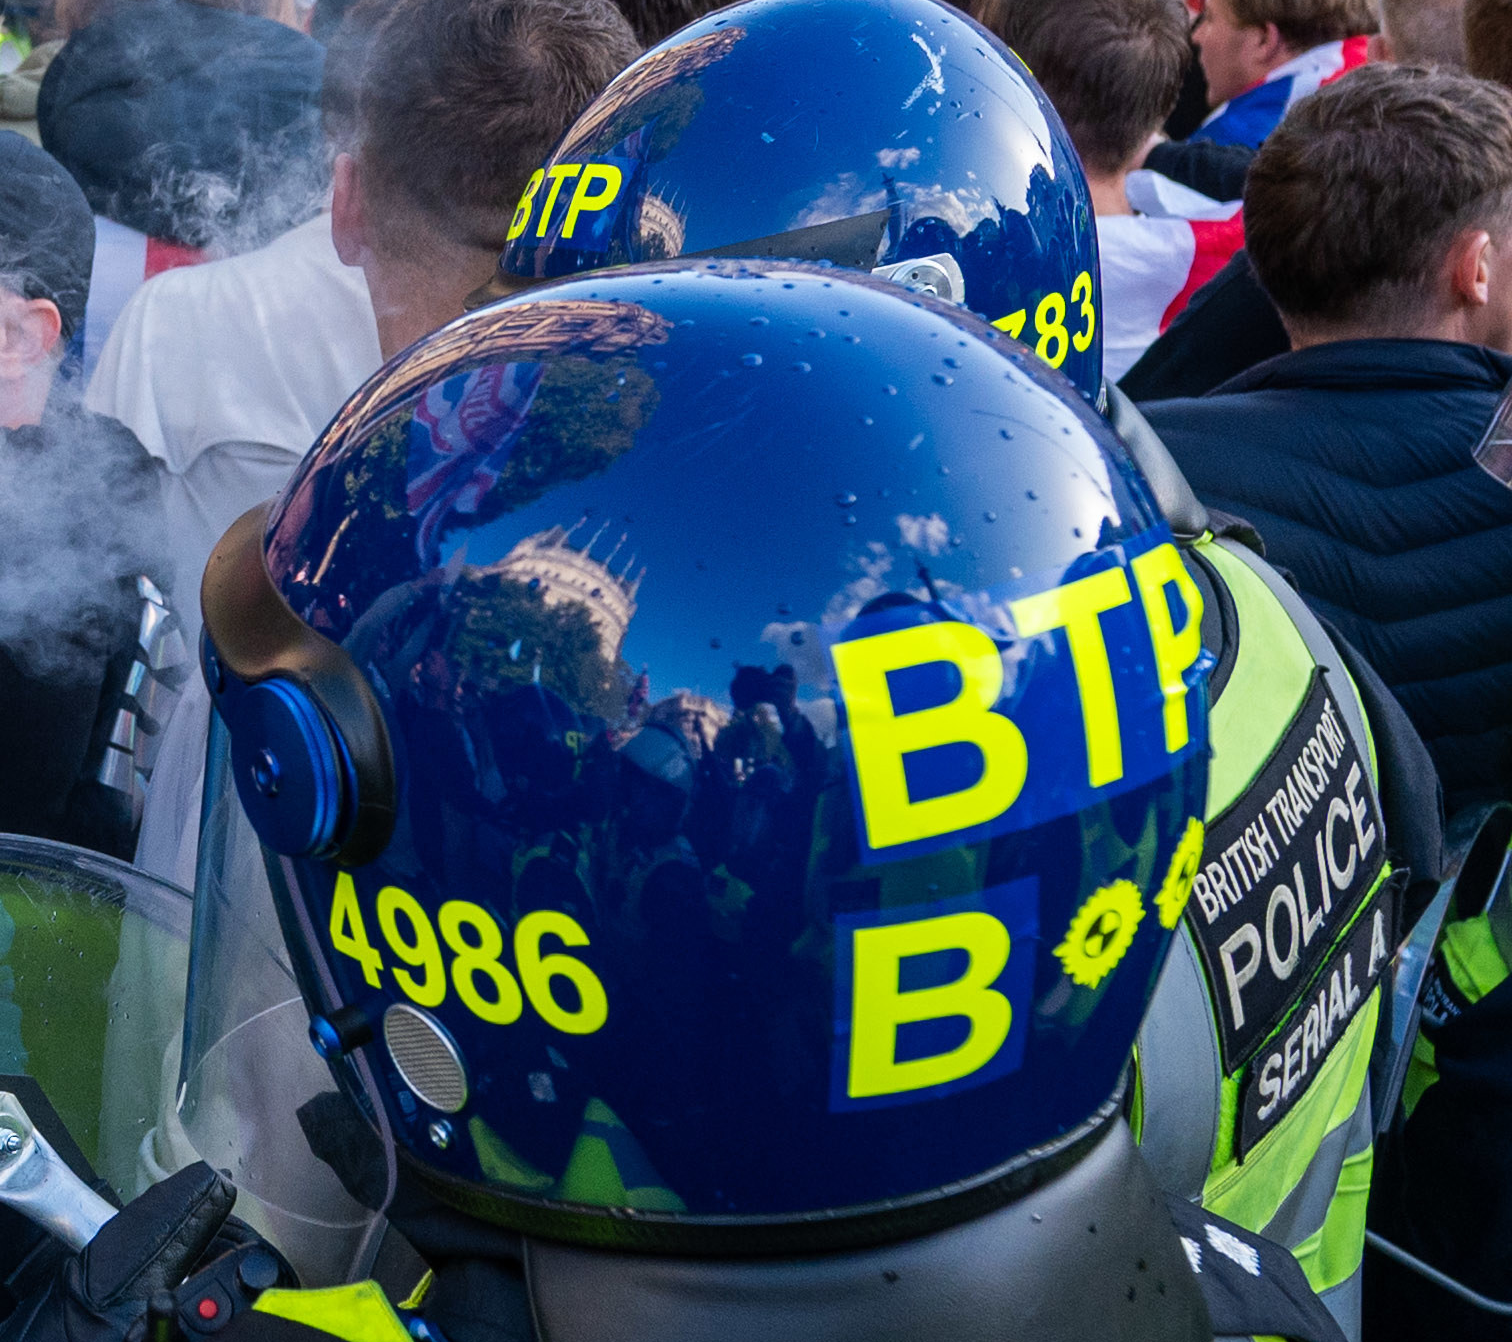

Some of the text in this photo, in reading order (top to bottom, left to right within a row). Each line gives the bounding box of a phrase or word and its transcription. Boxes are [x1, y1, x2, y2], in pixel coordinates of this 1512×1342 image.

[506, 163, 622, 241] BTP
[831, 541, 1205, 851] BTP
[1193, 697, 1348, 926] BRITISH TRANSPORT
[1219, 760, 1375, 1031] POLICE
[328, 870, 610, 1035] 4986
[849, 911, 1014, 1099] B
[1257, 908, 1387, 1121] SERIAL A
